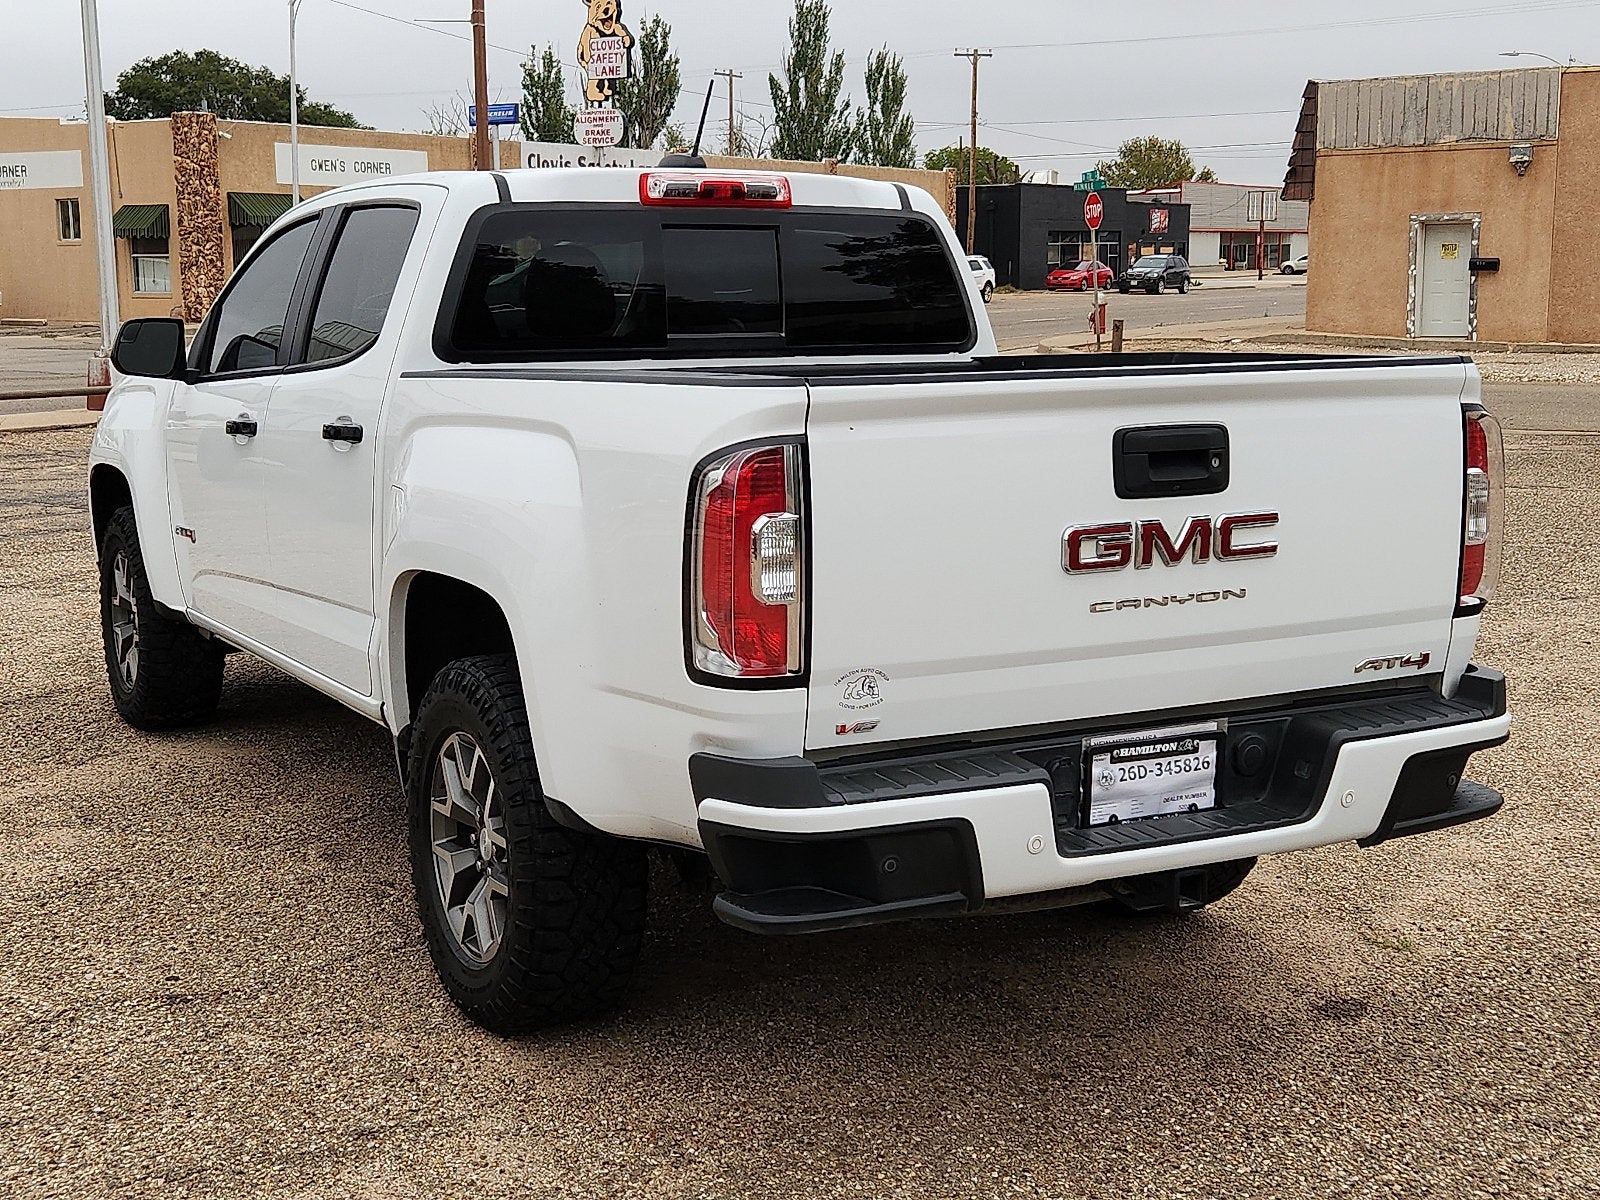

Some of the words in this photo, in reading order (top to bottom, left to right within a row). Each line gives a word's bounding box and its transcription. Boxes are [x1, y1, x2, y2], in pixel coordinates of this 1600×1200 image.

[590, 39, 622, 51] CLOVIS
[590, 52, 626, 64] SAFETY
[595, 66, 621, 77] LANE
[582, 136, 615, 144] SERVICE
[0, 165, 28, 178] RNER
[353, 161, 392, 174] CORNER
[1086, 204, 1101, 219] STOP
[1061, 509, 1280, 575] GMC
[1089, 587, 1248, 614] CANYON
[1354, 650, 1432, 674] AT4
[833, 668, 860, 687] HAMILTON
[835, 720, 880, 735] V6
[1119, 742, 1178, 757] HAMILTON
[1118, 755, 1211, 782] 26D-345826
[1162, 795, 1184, 803] DEALER
[1184, 791, 1208, 800] NUMBER
